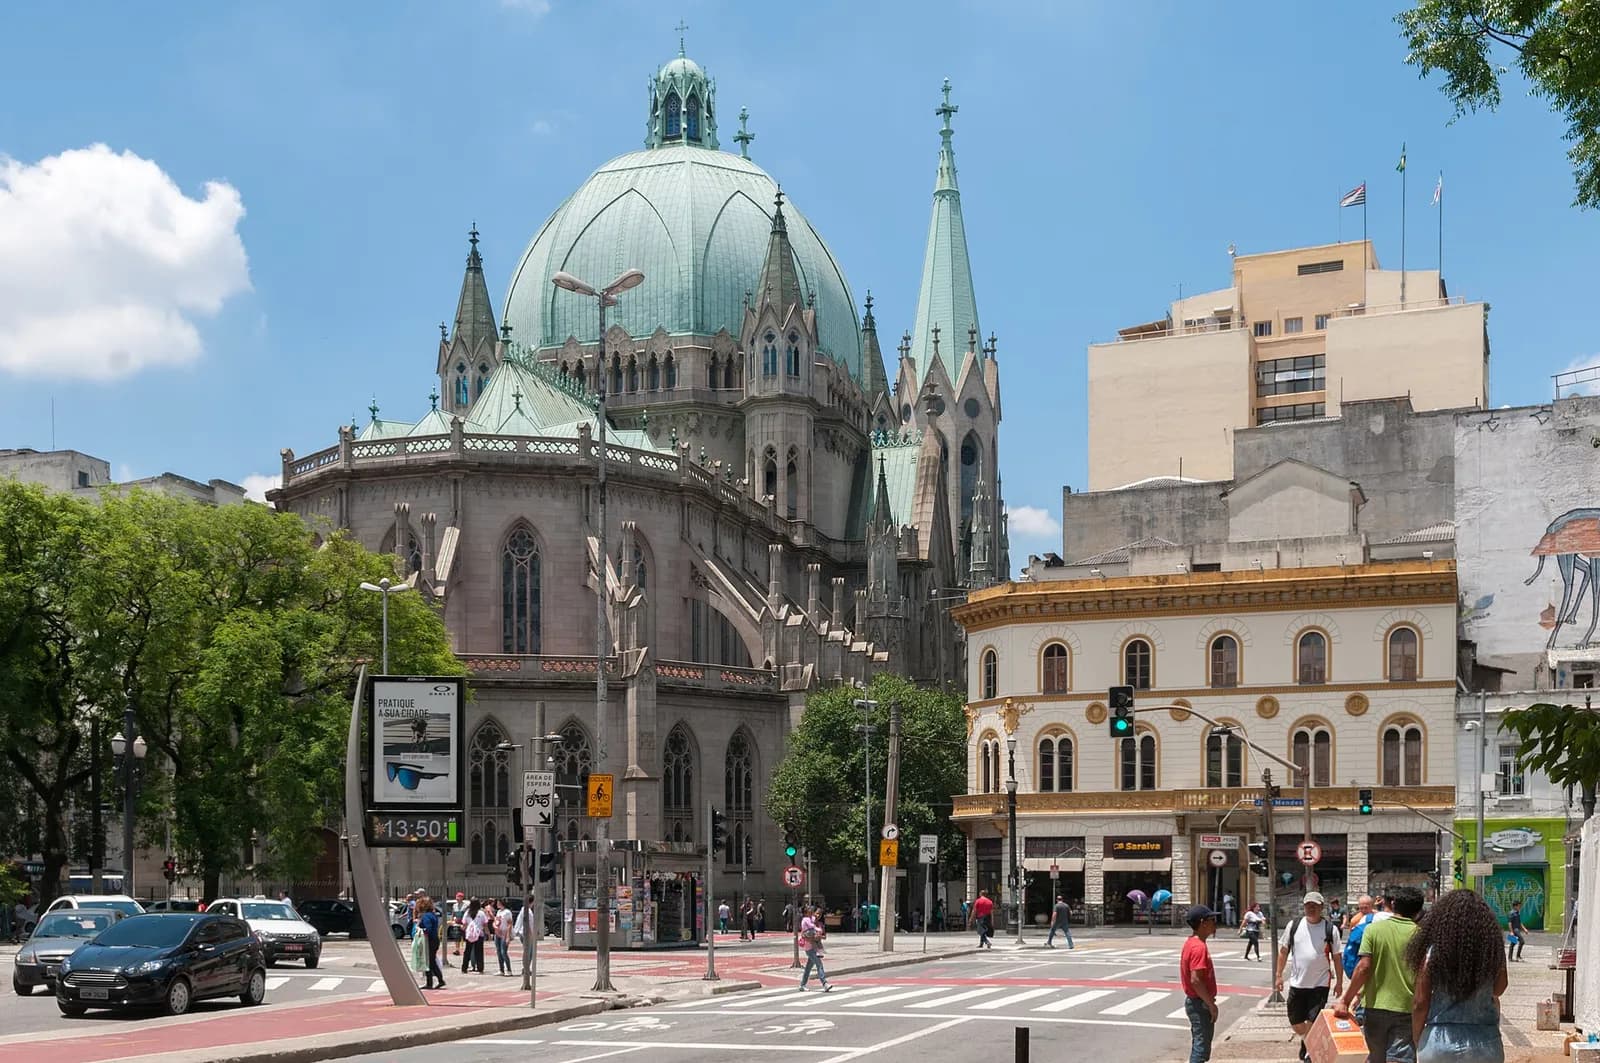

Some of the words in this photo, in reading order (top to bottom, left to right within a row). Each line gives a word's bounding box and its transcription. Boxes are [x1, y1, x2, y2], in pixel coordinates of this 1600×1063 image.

[378, 699, 415, 709] PRATIQUE
[378, 709, 383, 717] A
[384, 709, 400, 718] SUA
[386, 820, 441, 838] 13:50
[1125, 841, 1161, 850] Saraiva
